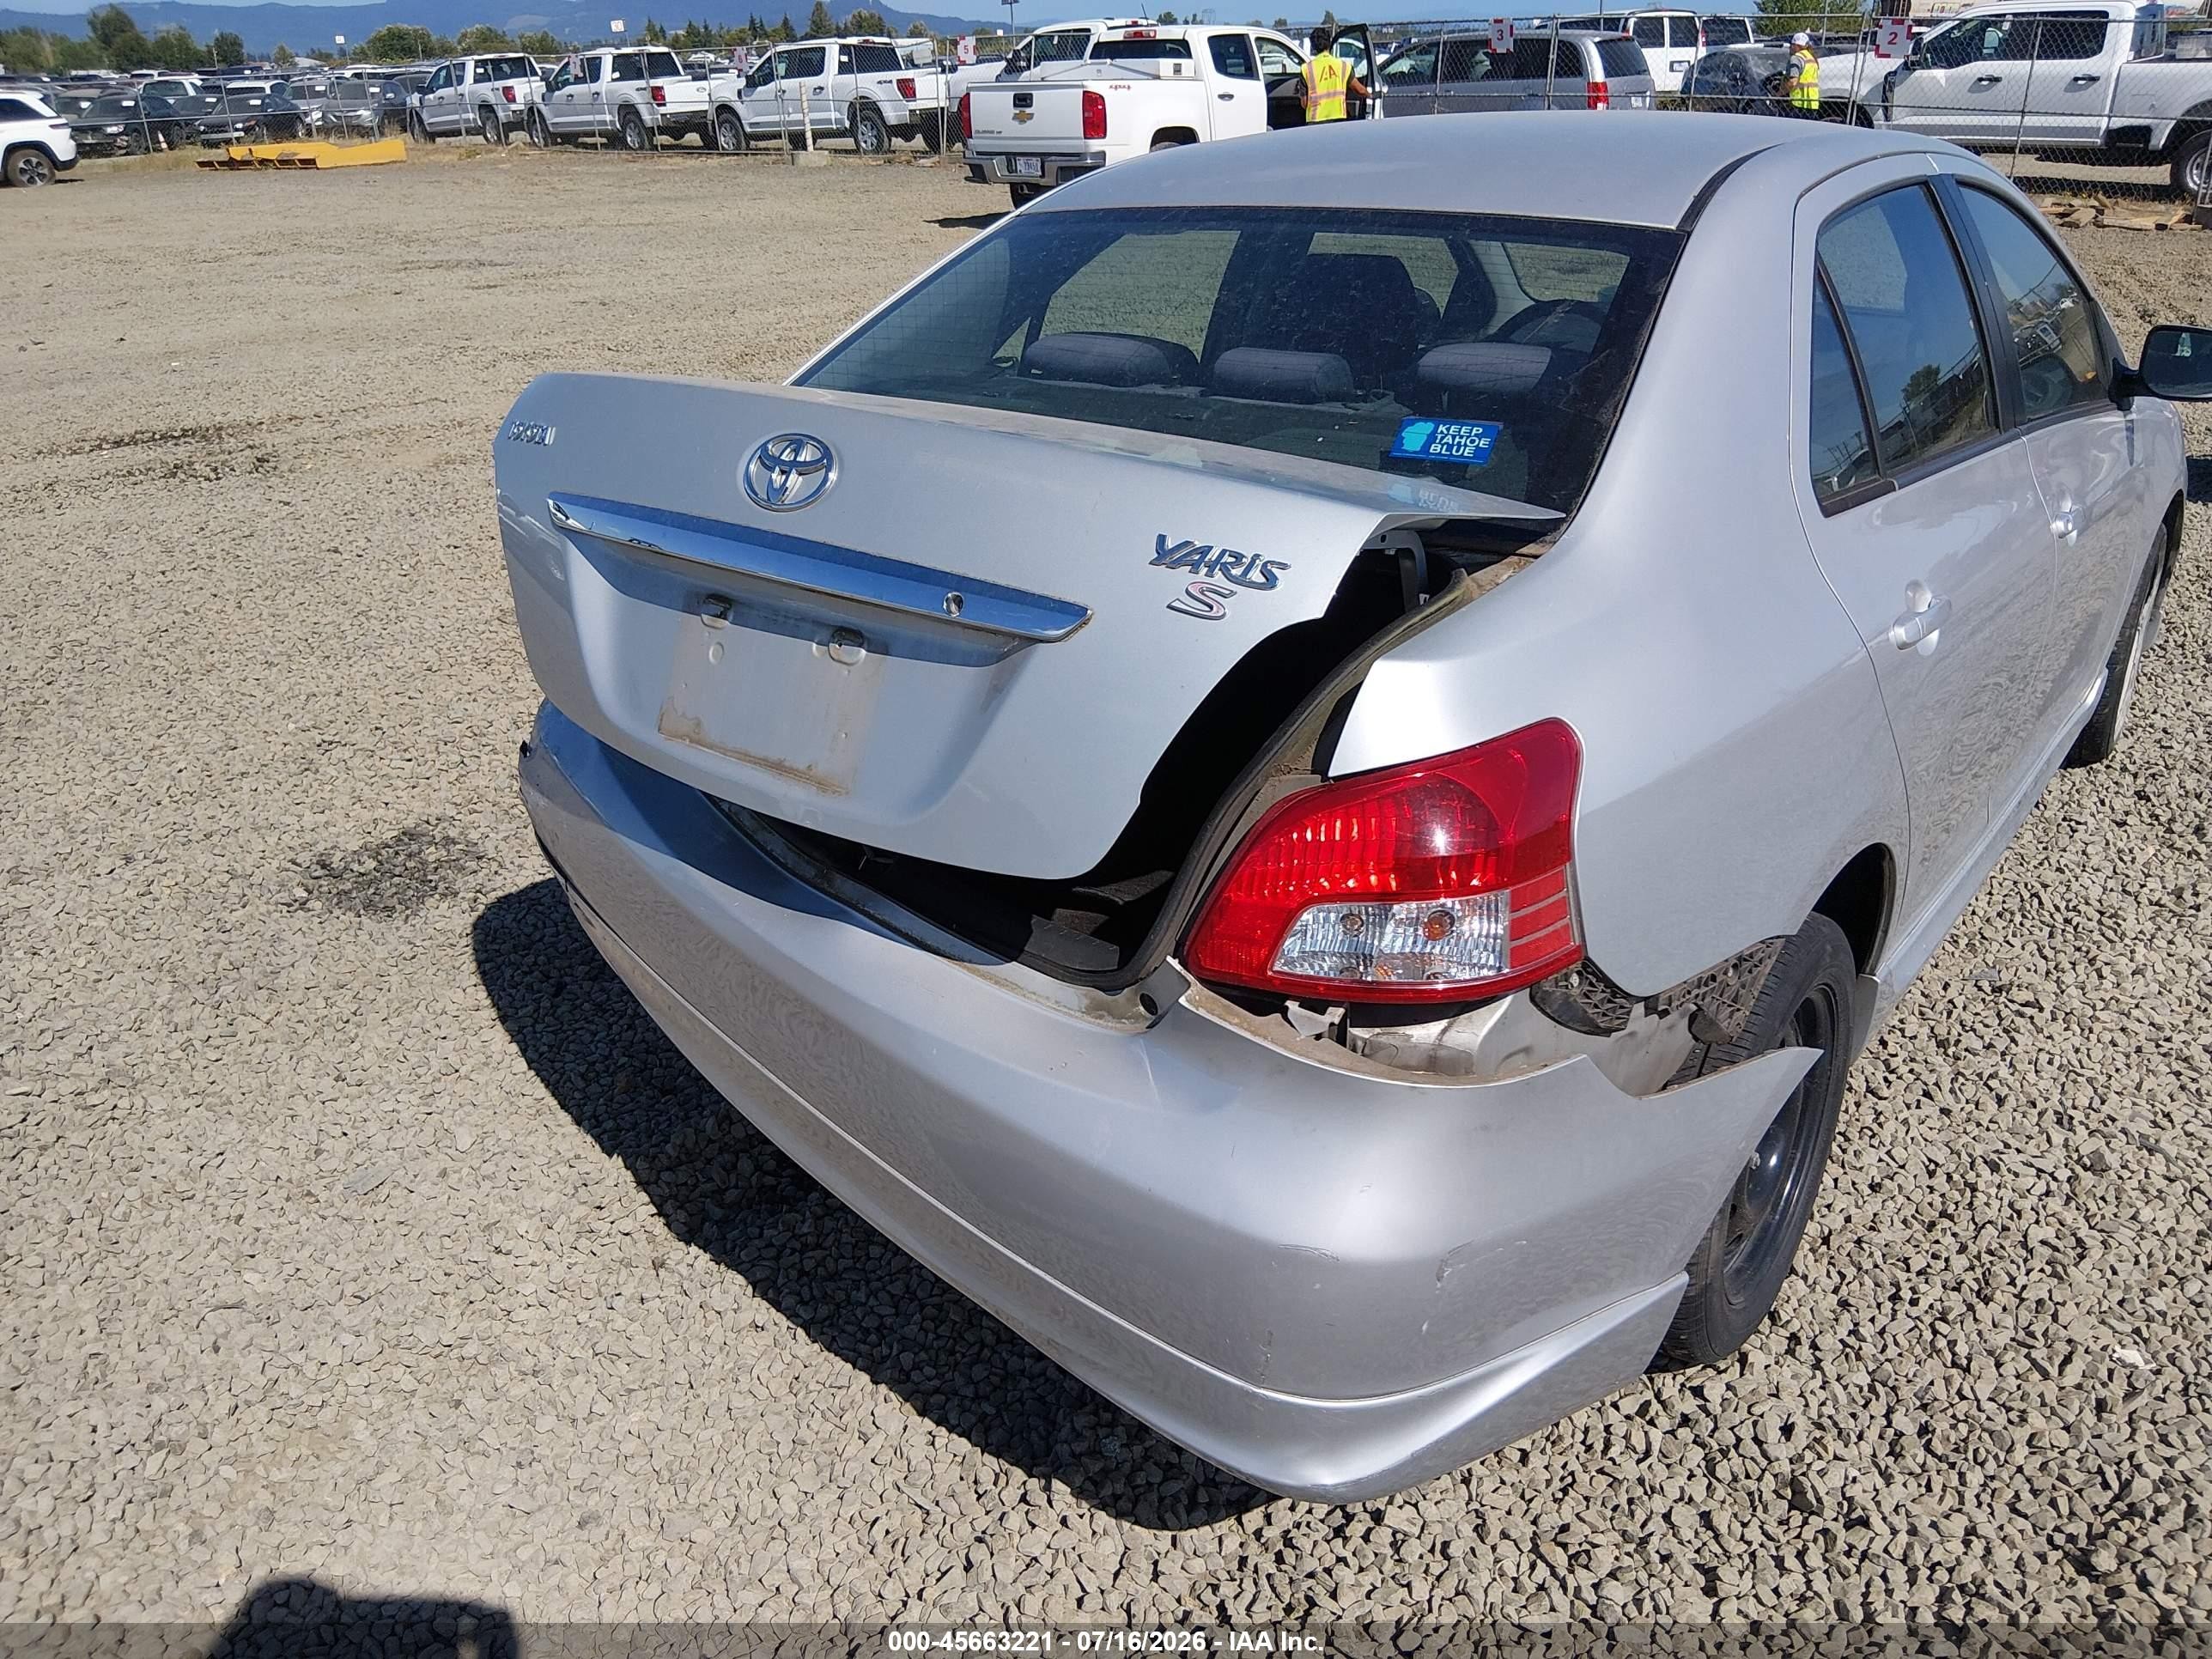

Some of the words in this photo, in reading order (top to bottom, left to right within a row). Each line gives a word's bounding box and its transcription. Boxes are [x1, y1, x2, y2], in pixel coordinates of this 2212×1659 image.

[1496, 28, 1504, 41] 3
[1887, 31, 1899, 46] 2
[963, 44, 969, 55] 5
[1437, 423, 1484, 436] KEEP
[1435, 433, 1492, 448] TAHOE
[1429, 443, 1476, 457] BLUE
[1148, 532, 1291, 592] YARIS
[1165, 580, 1237, 621] S
